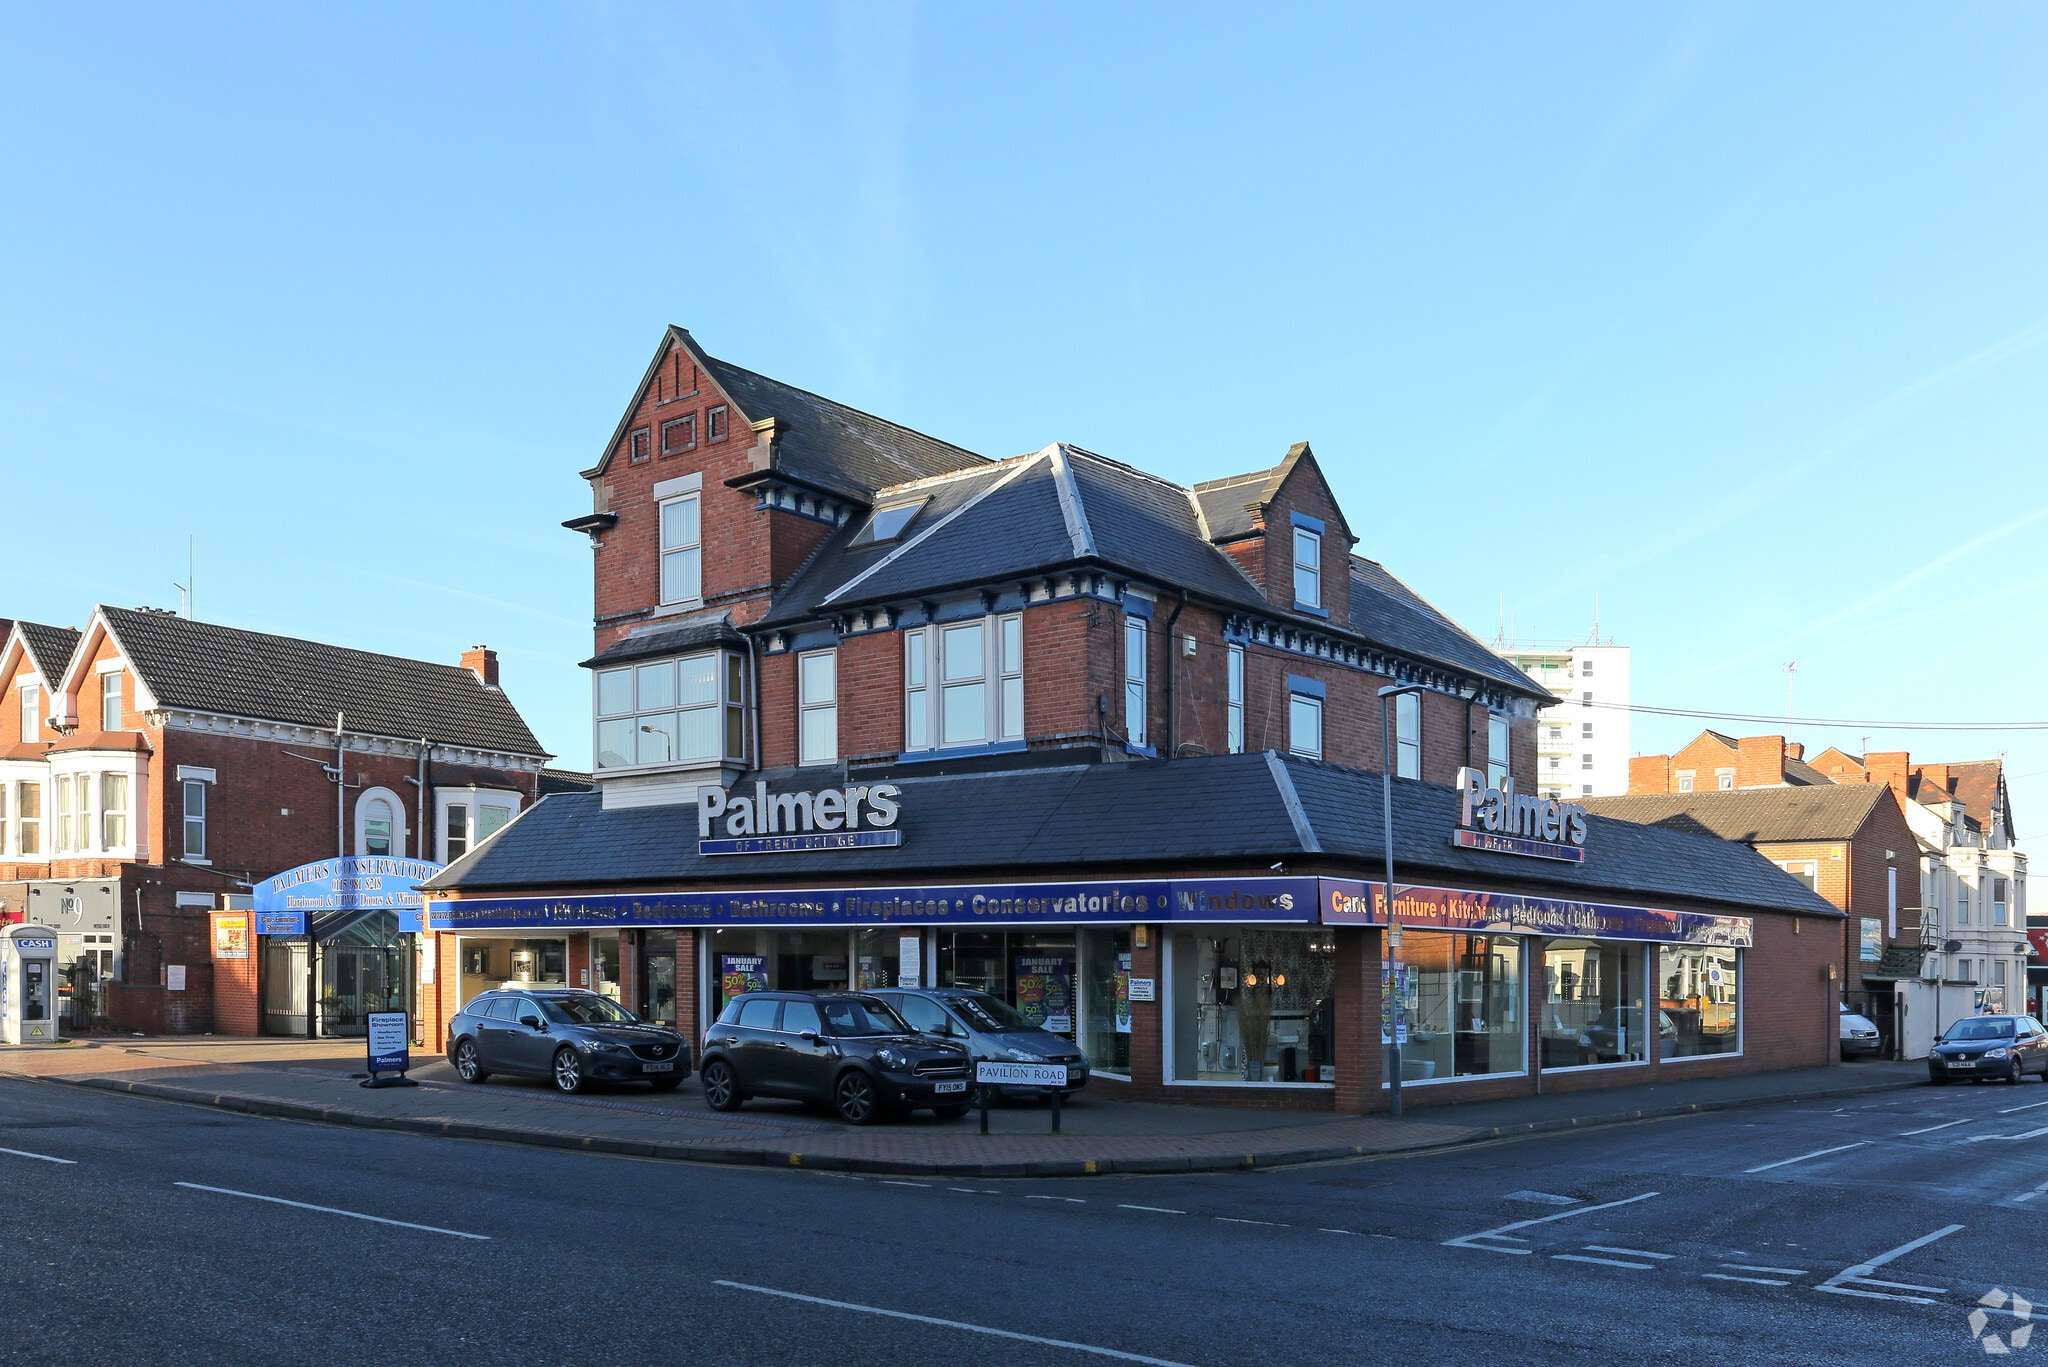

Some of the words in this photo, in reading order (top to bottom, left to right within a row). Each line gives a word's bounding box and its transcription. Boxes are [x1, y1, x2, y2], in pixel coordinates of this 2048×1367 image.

[698, 781, 898, 836] Palmers
[1458, 767, 1587, 844] Palmers
[736, 841, 750, 852] OF
[758, 838, 797, 851] TRENT
[272, 862, 329, 894] PALMERS
[331, 878, 347, 892] 0115
[286, 895, 323, 909] Hardwood
[360, 893, 383, 907] Doors
[396, 892, 424, 906] Windo
[633, 901, 711, 918] Bedrooms
[730, 899, 825, 917] Bathrooms
[846, 897, 949, 920] Fireplaces
[972, 890, 1148, 914] Conservatories
[1177, 890, 1294, 912] Windows
[21, 940, 49, 948] CASH
[1021, 958, 1063, 966] JANUARY
[725, 974, 745, 989] 50%
[746, 981, 762, 992] 50%
[1019, 977, 1043, 994] 50%
[979, 1066, 1028, 1079] PAVILION
[1034, 1069, 1065, 1080] ROAD
